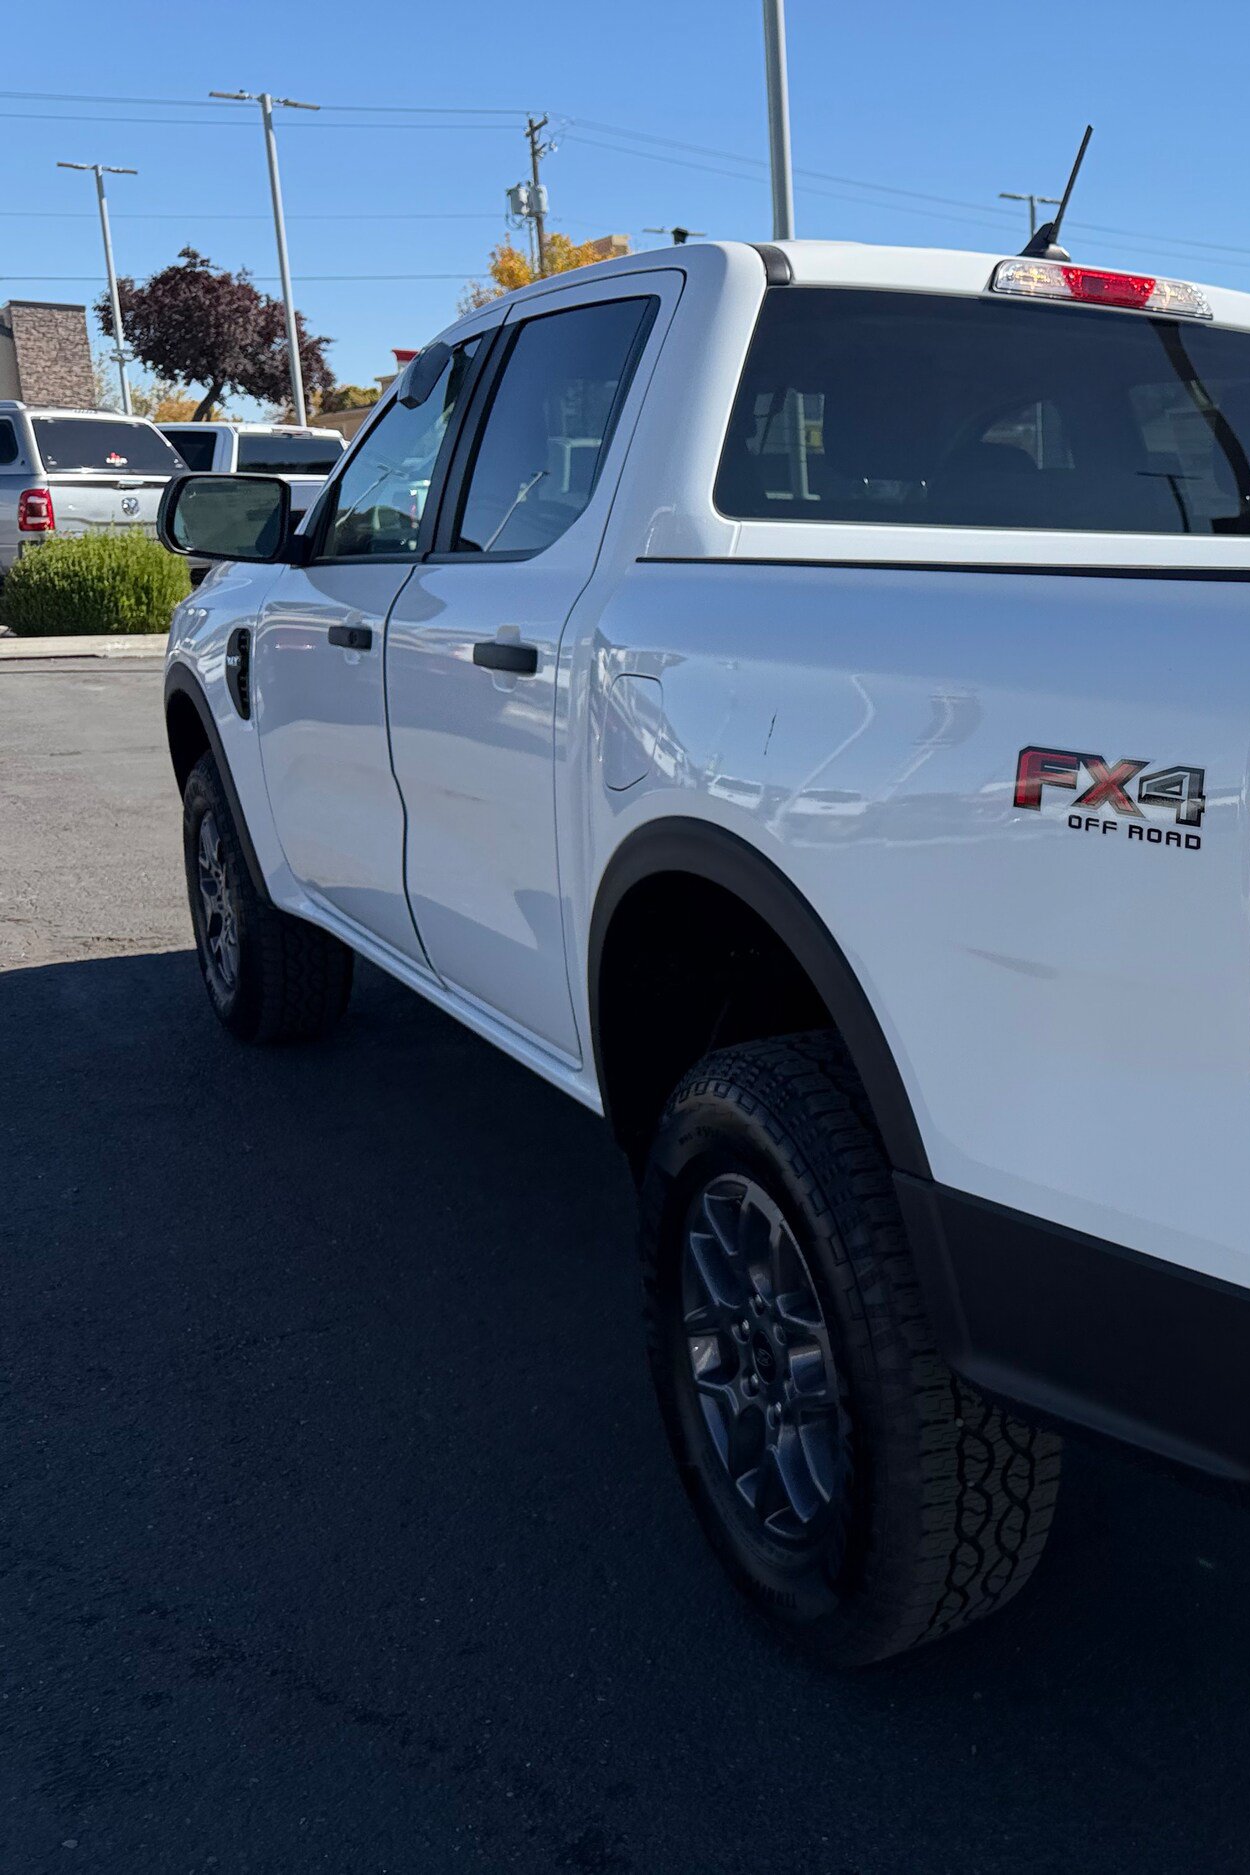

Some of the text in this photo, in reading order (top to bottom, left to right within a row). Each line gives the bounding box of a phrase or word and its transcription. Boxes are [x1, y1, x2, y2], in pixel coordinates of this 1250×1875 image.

[1013, 745, 1206, 827] FX4
[1068, 814, 1201, 850] OFF ROAD
